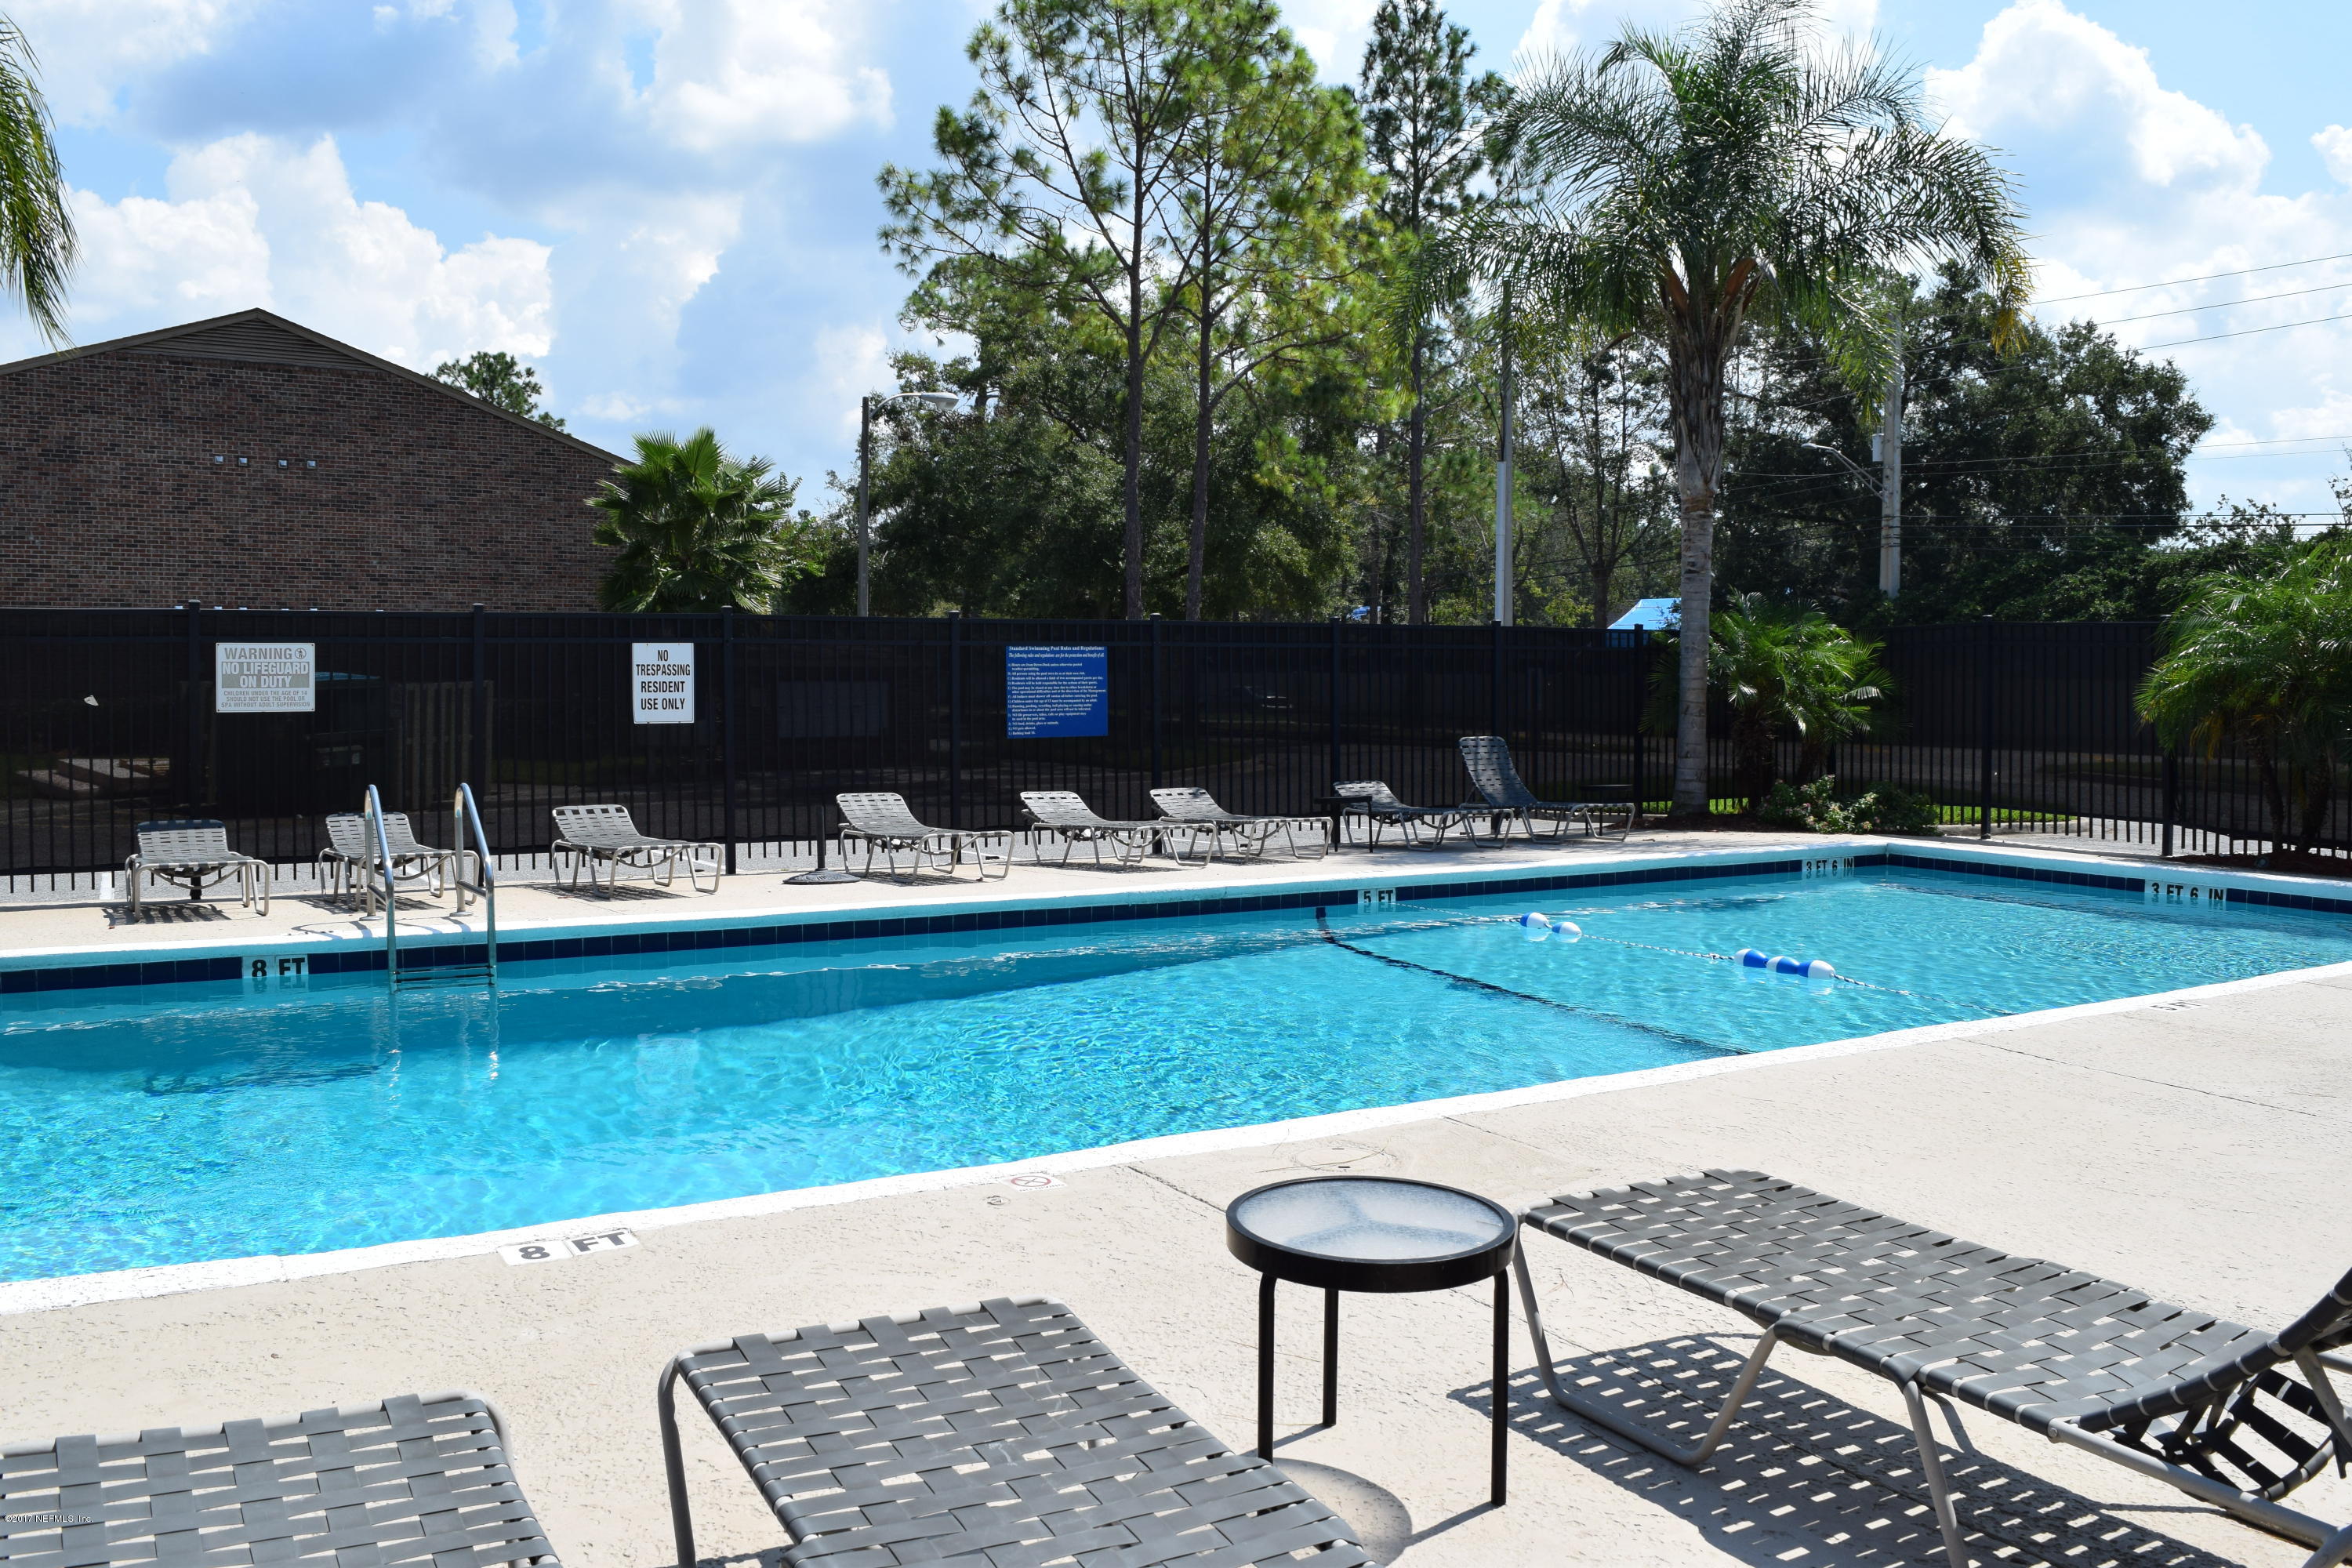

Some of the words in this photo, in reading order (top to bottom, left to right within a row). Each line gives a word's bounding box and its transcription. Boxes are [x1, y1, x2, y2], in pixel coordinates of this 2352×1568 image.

[224, 648, 292, 659] WARNING
[658, 650, 668, 662] NO
[222, 662, 239, 674] NO
[243, 662, 309, 674] LIFEGUARD
[636, 664, 690, 676] TRESPASSING
[240, 675, 256, 688] ON
[261, 675, 292, 688] DUTY
[641, 681, 685, 693] RESIDENT
[641, 698, 659, 710] USE
[662, 698, 685, 710] ONLY
[1806, 861, 1812, 871] 3
[1817, 860, 1827, 870] FT
[1832, 860, 1838, 869] 6
[1844, 858, 1853, 868] IN
[1363, 891, 1371, 902] 5
[1378, 890, 1393, 903] FT
[2151, 882, 2160, 893] 3
[2167, 884, 2183, 895] FT
[2190, 887, 2198, 898] 6
[2209, 888, 2223, 900] IN
[252, 959, 267, 977] 8
[278, 957, 306, 976] FT
[518, 1246, 550, 1260] 8
[572, 1232, 625, 1253] FT
